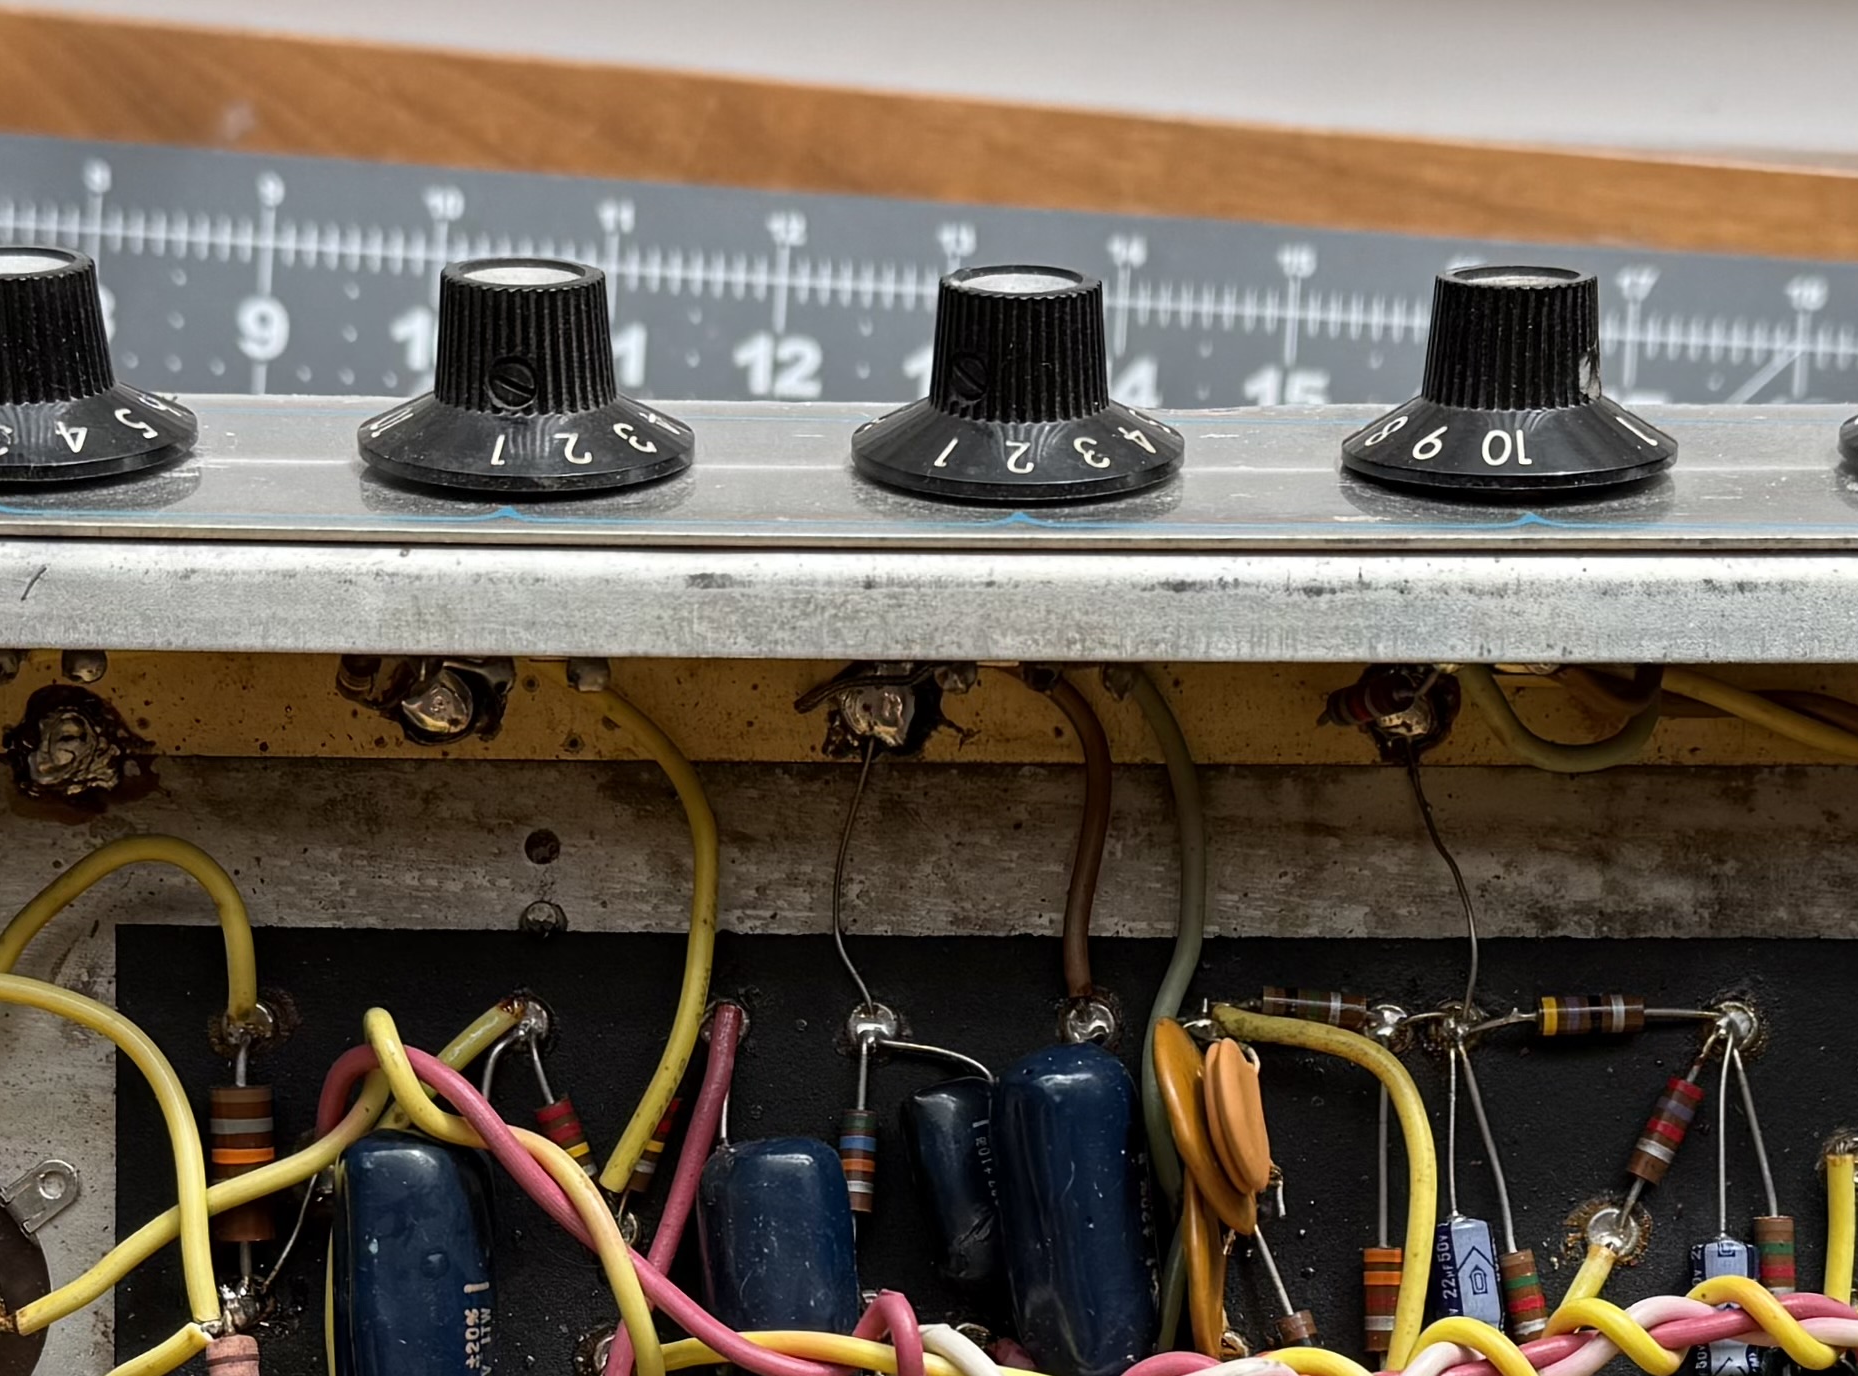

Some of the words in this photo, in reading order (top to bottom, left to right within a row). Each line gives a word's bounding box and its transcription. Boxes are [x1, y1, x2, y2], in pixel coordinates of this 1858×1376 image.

[235, 296, 291, 363] 9
[389, 304, 436, 372] 1
[732, 332, 825, 400] 12
[53, 420, 88, 454] 4
[114, 408, 159, 439] 5
[612, 422, 658, 453] 3
[1117, 426, 1157, 454] 4
[1364, 415, 1409, 447] 8
[490, 434, 507, 466] 1
[552, 432, 593, 465] 2
[932, 438, 959, 467] 1
[1004, 439, 1035, 474] 2
[1073, 436, 1111, 469] 3
[1412, 425, 1448, 460] 9
[1481, 429, 1533, 467] 10
